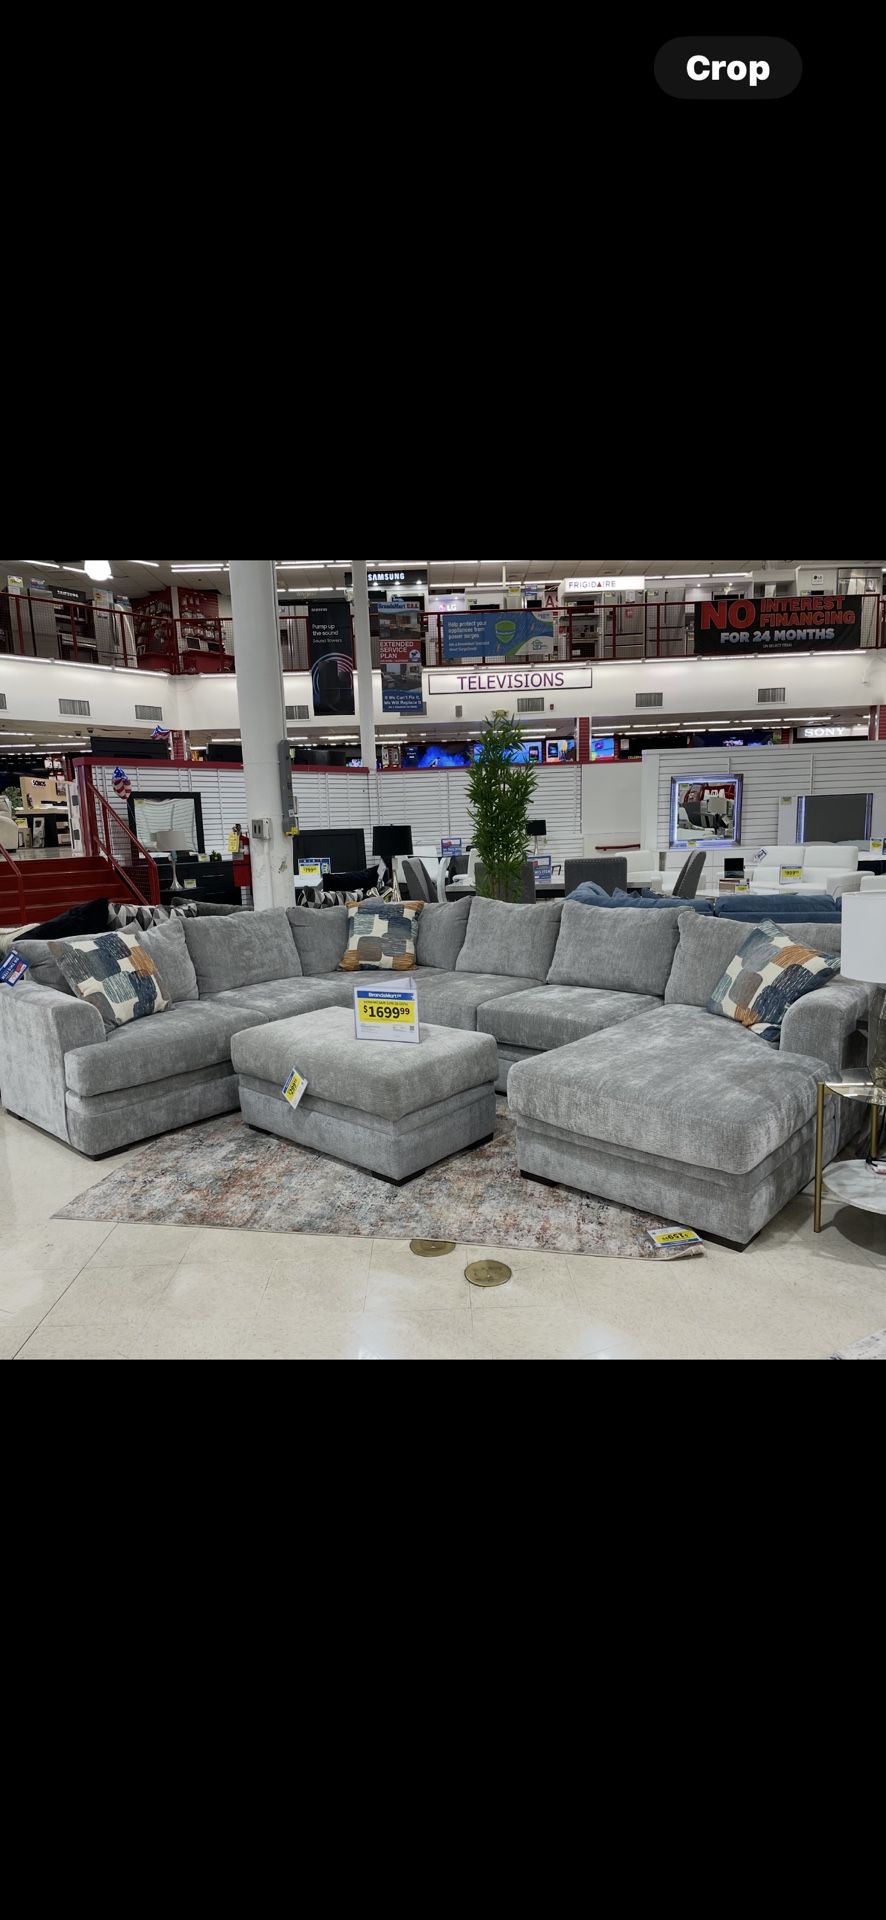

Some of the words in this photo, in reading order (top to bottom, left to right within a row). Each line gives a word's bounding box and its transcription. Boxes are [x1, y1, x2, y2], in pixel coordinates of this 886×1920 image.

[367, 573, 405, 581] SAMSUNG
[760, 596, 845, 612] INTEREST
[700, 599, 756, 630] NO
[760, 610, 856, 627] FINANCING
[720, 631, 750, 643] FOR
[752, 631, 771, 642] 24
[773, 628, 835, 641] MONTHS
[456, 672, 565, 691] TELEVISIONS
[804, 727, 845, 737] SONY
